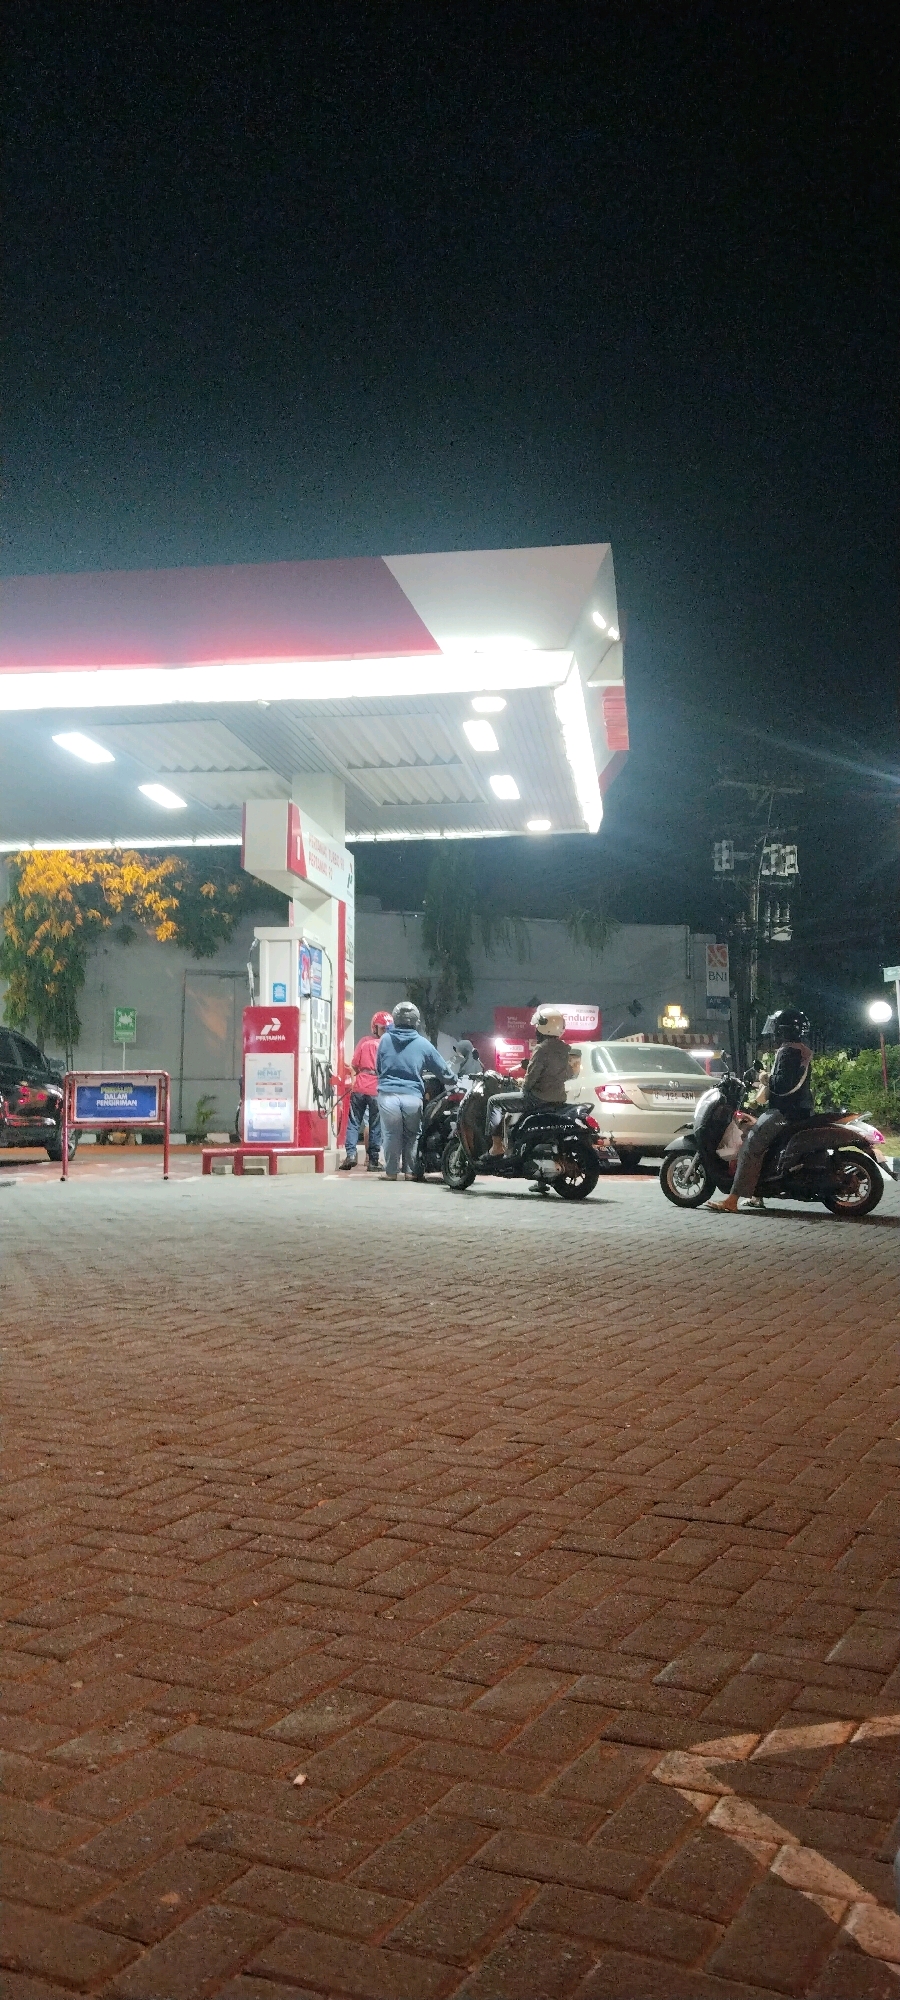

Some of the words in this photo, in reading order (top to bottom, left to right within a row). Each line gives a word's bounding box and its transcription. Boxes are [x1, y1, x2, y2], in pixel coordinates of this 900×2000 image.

[296, 836, 300, 860] 1
[708, 971, 727, 981] BNI
[562, 1013, 596, 1022] Enduro
